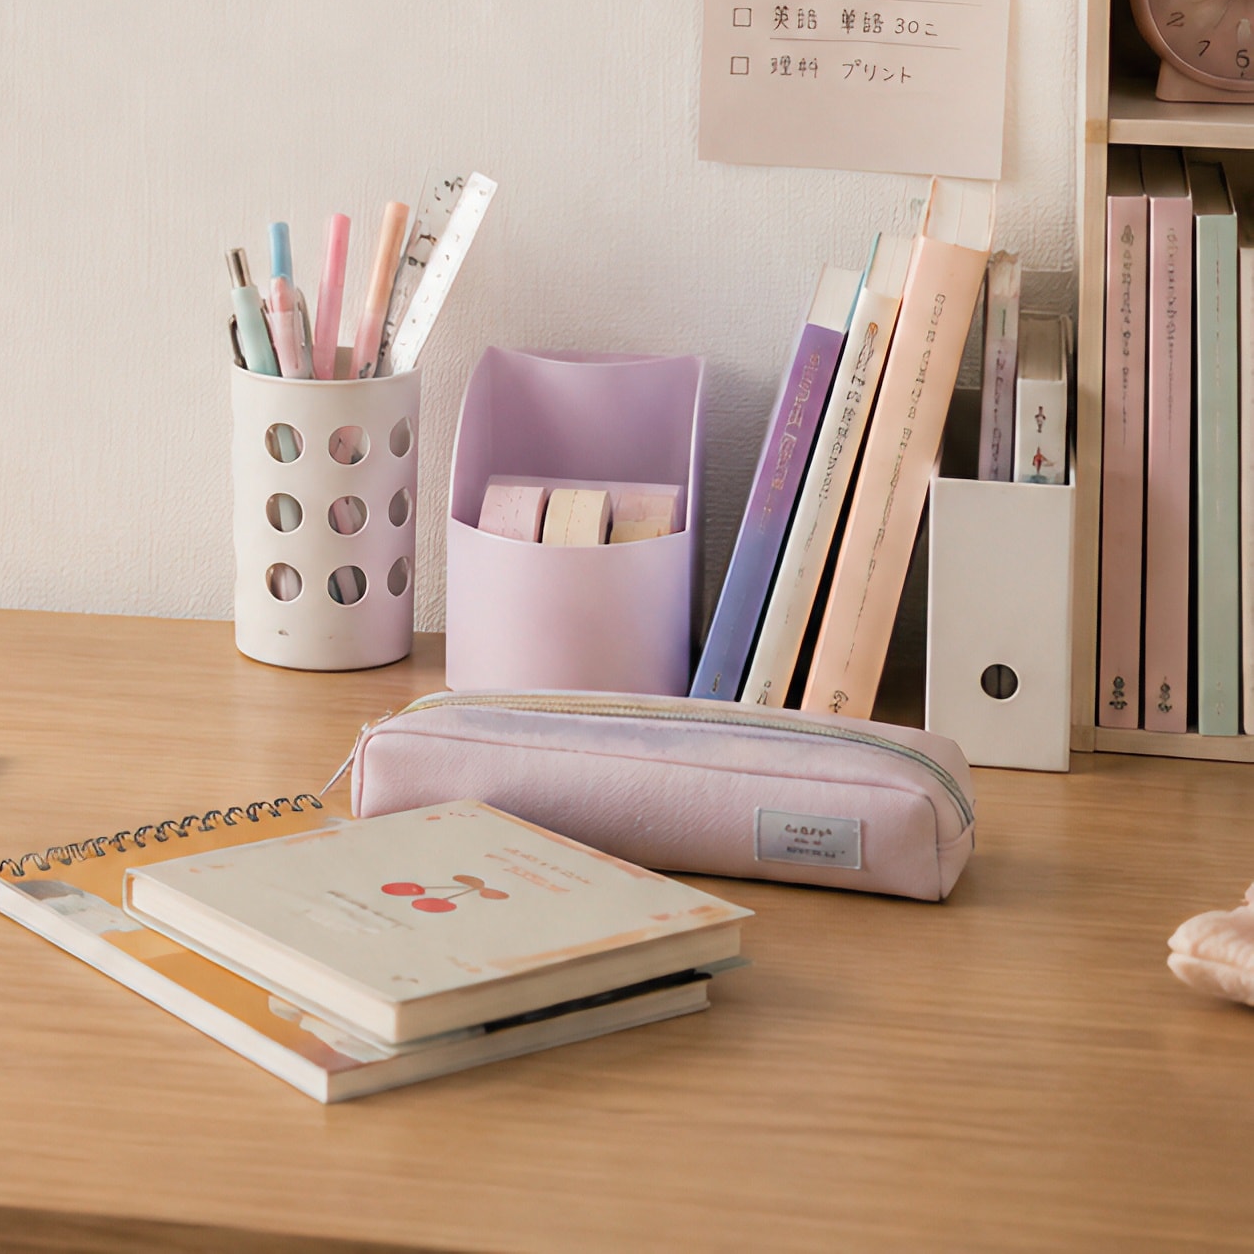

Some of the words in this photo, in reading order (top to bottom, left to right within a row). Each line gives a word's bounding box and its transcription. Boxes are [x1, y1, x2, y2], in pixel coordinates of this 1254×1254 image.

[1235, 49, 1250, 69] 6
[841, 58, 912, 84] プリント
